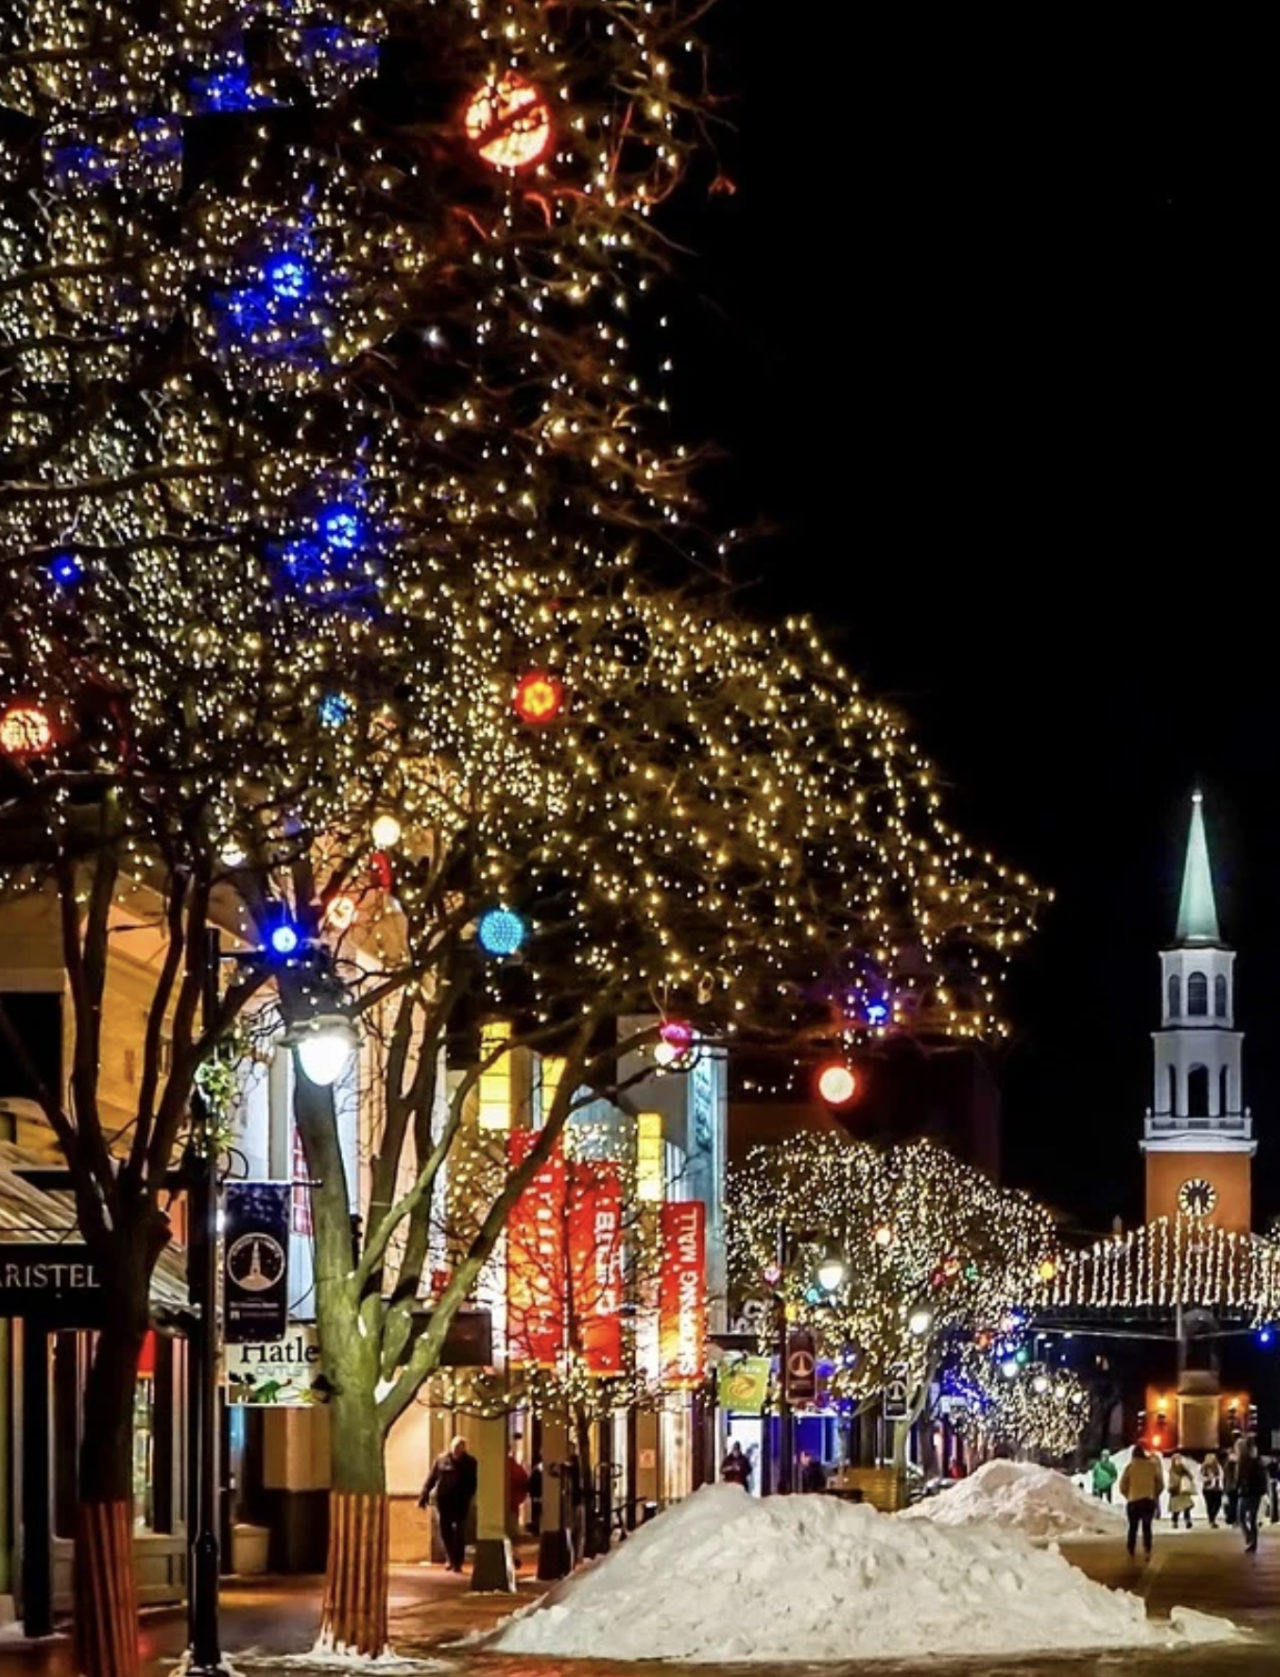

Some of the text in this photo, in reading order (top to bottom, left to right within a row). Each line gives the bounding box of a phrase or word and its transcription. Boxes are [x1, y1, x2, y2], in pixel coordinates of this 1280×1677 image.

[0, 1263, 101, 1288] RISTEL
[677, 1208, 698, 1375] SHOPPING MALL
